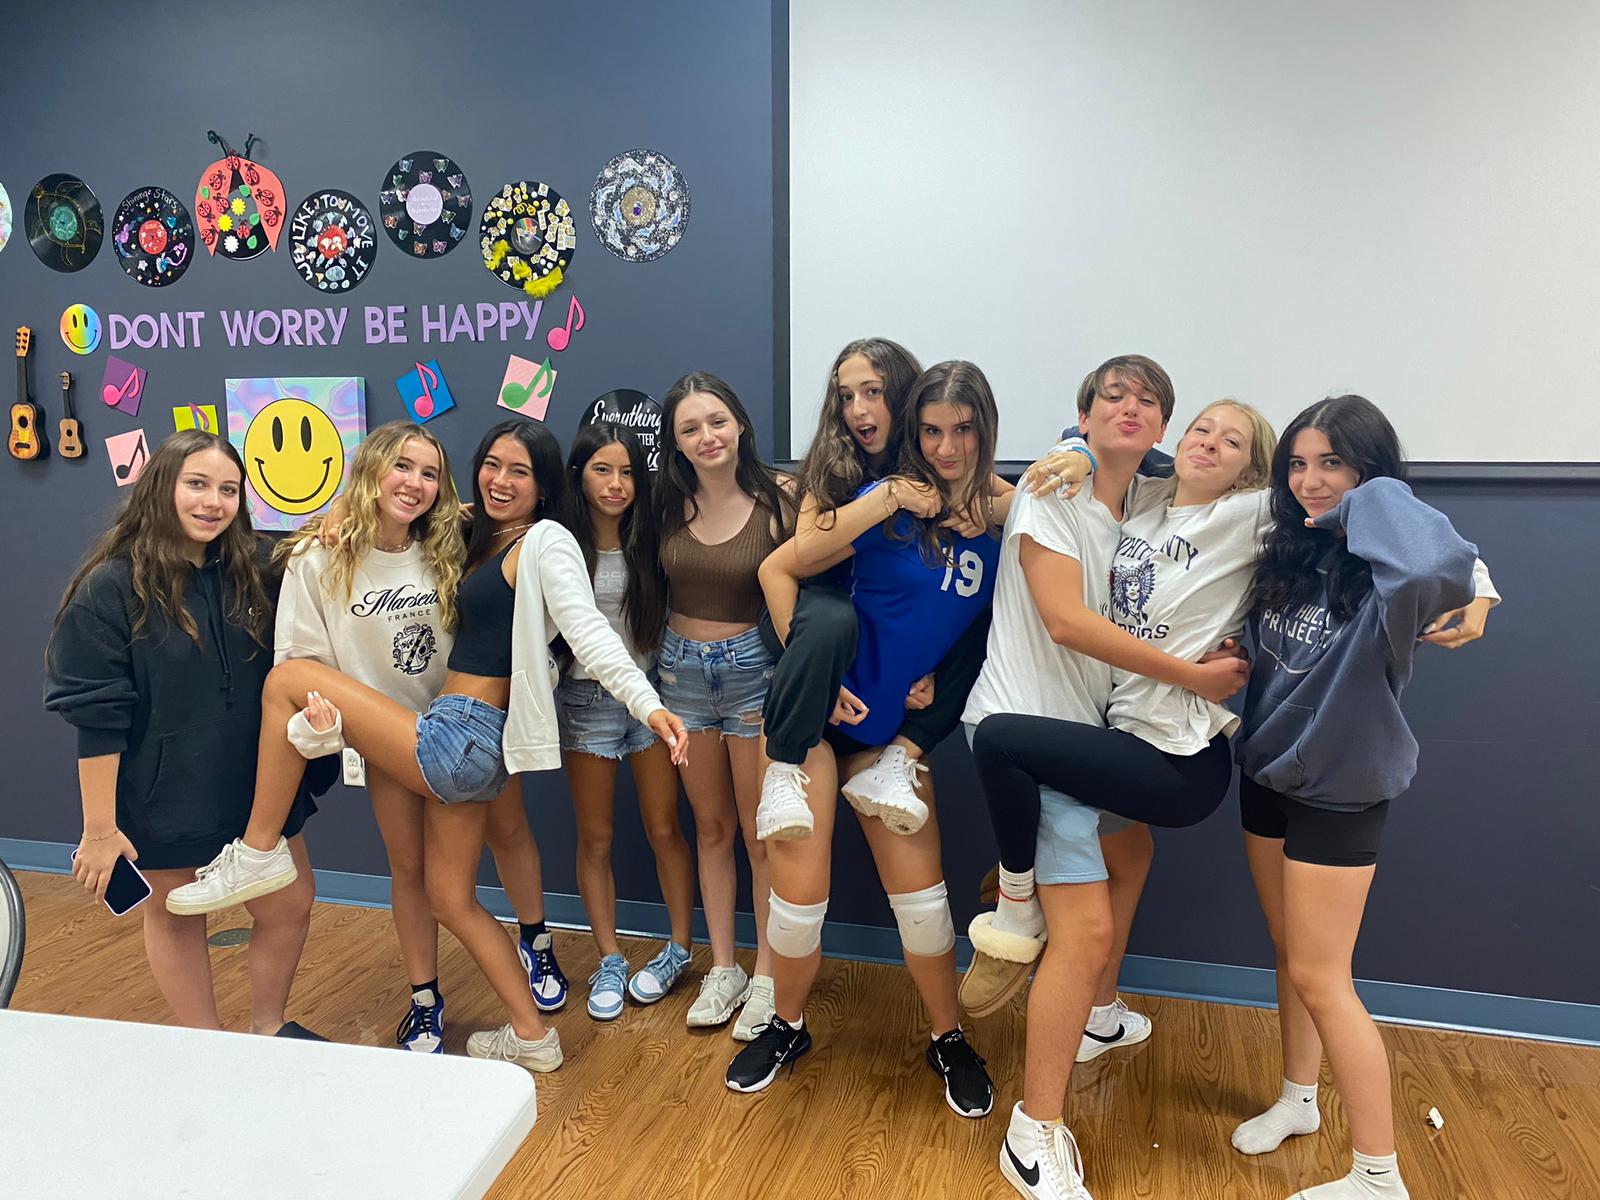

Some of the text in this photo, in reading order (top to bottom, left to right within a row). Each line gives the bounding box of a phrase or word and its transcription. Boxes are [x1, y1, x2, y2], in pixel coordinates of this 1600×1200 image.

[153, 188, 177, 209] Stars
[320, 194, 338, 209] TO
[292, 201, 315, 240] LIKE
[344, 201, 374, 249] MOVE
[352, 256, 369, 281] IT
[108, 300, 543, 350] DONT WORRY BE HAPPY
[940, 546, 984, 598] 19
[351, 584, 440, 618] Marseil
[387, 608, 432, 623] FRANCE
